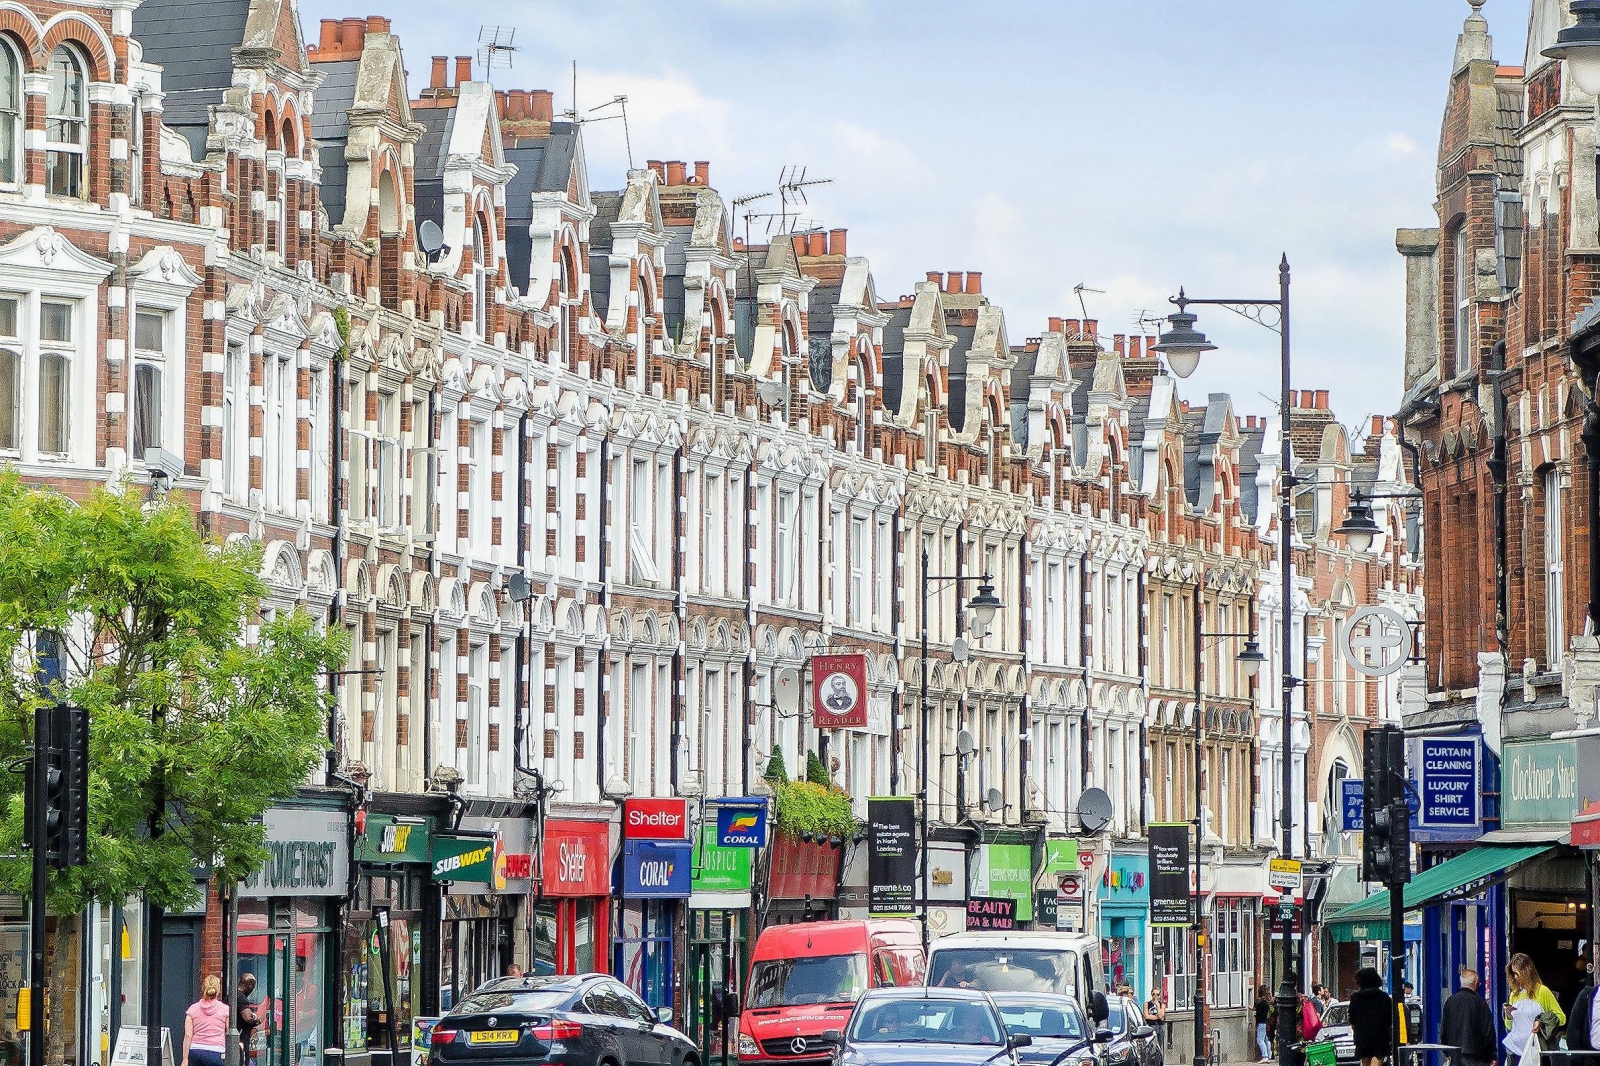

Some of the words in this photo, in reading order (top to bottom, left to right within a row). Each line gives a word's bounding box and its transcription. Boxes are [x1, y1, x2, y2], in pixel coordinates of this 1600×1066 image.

[819, 662, 858, 671] HENRY
[819, 716, 861, 725] READER
[1426, 747, 1471, 757] CURTAIN
[1425, 760, 1472, 770] CLEANING
[1511, 754, 1554, 801] Clocktower
[1557, 754, 1575, 799] Store
[1428, 781, 1469, 791] LUXURY
[1434, 794, 1463, 804] SHIRT
[1429, 807, 1470, 816] SERVICE
[629, 810, 682, 826] Shelter
[380, 825, 412, 853] SUBWAY
[723, 835, 759, 844] CORAL
[433, 846, 491, 876] SUBWAY
[560, 842, 587, 882] Shelter
[702, 850, 737, 871] OSPICE
[640, 860, 669, 887] CORAL
[968, 900, 1012, 915] BEAUTY
[966, 916, 980, 927] SPA
[982, 917, 990, 927] &
[992, 917, 1012, 928] NAILS
[757, 1015, 845, 1026] www.parcelforce.com
[476, 1032, 494, 1041] LS14
[496, 1031, 513, 1039] KRX
